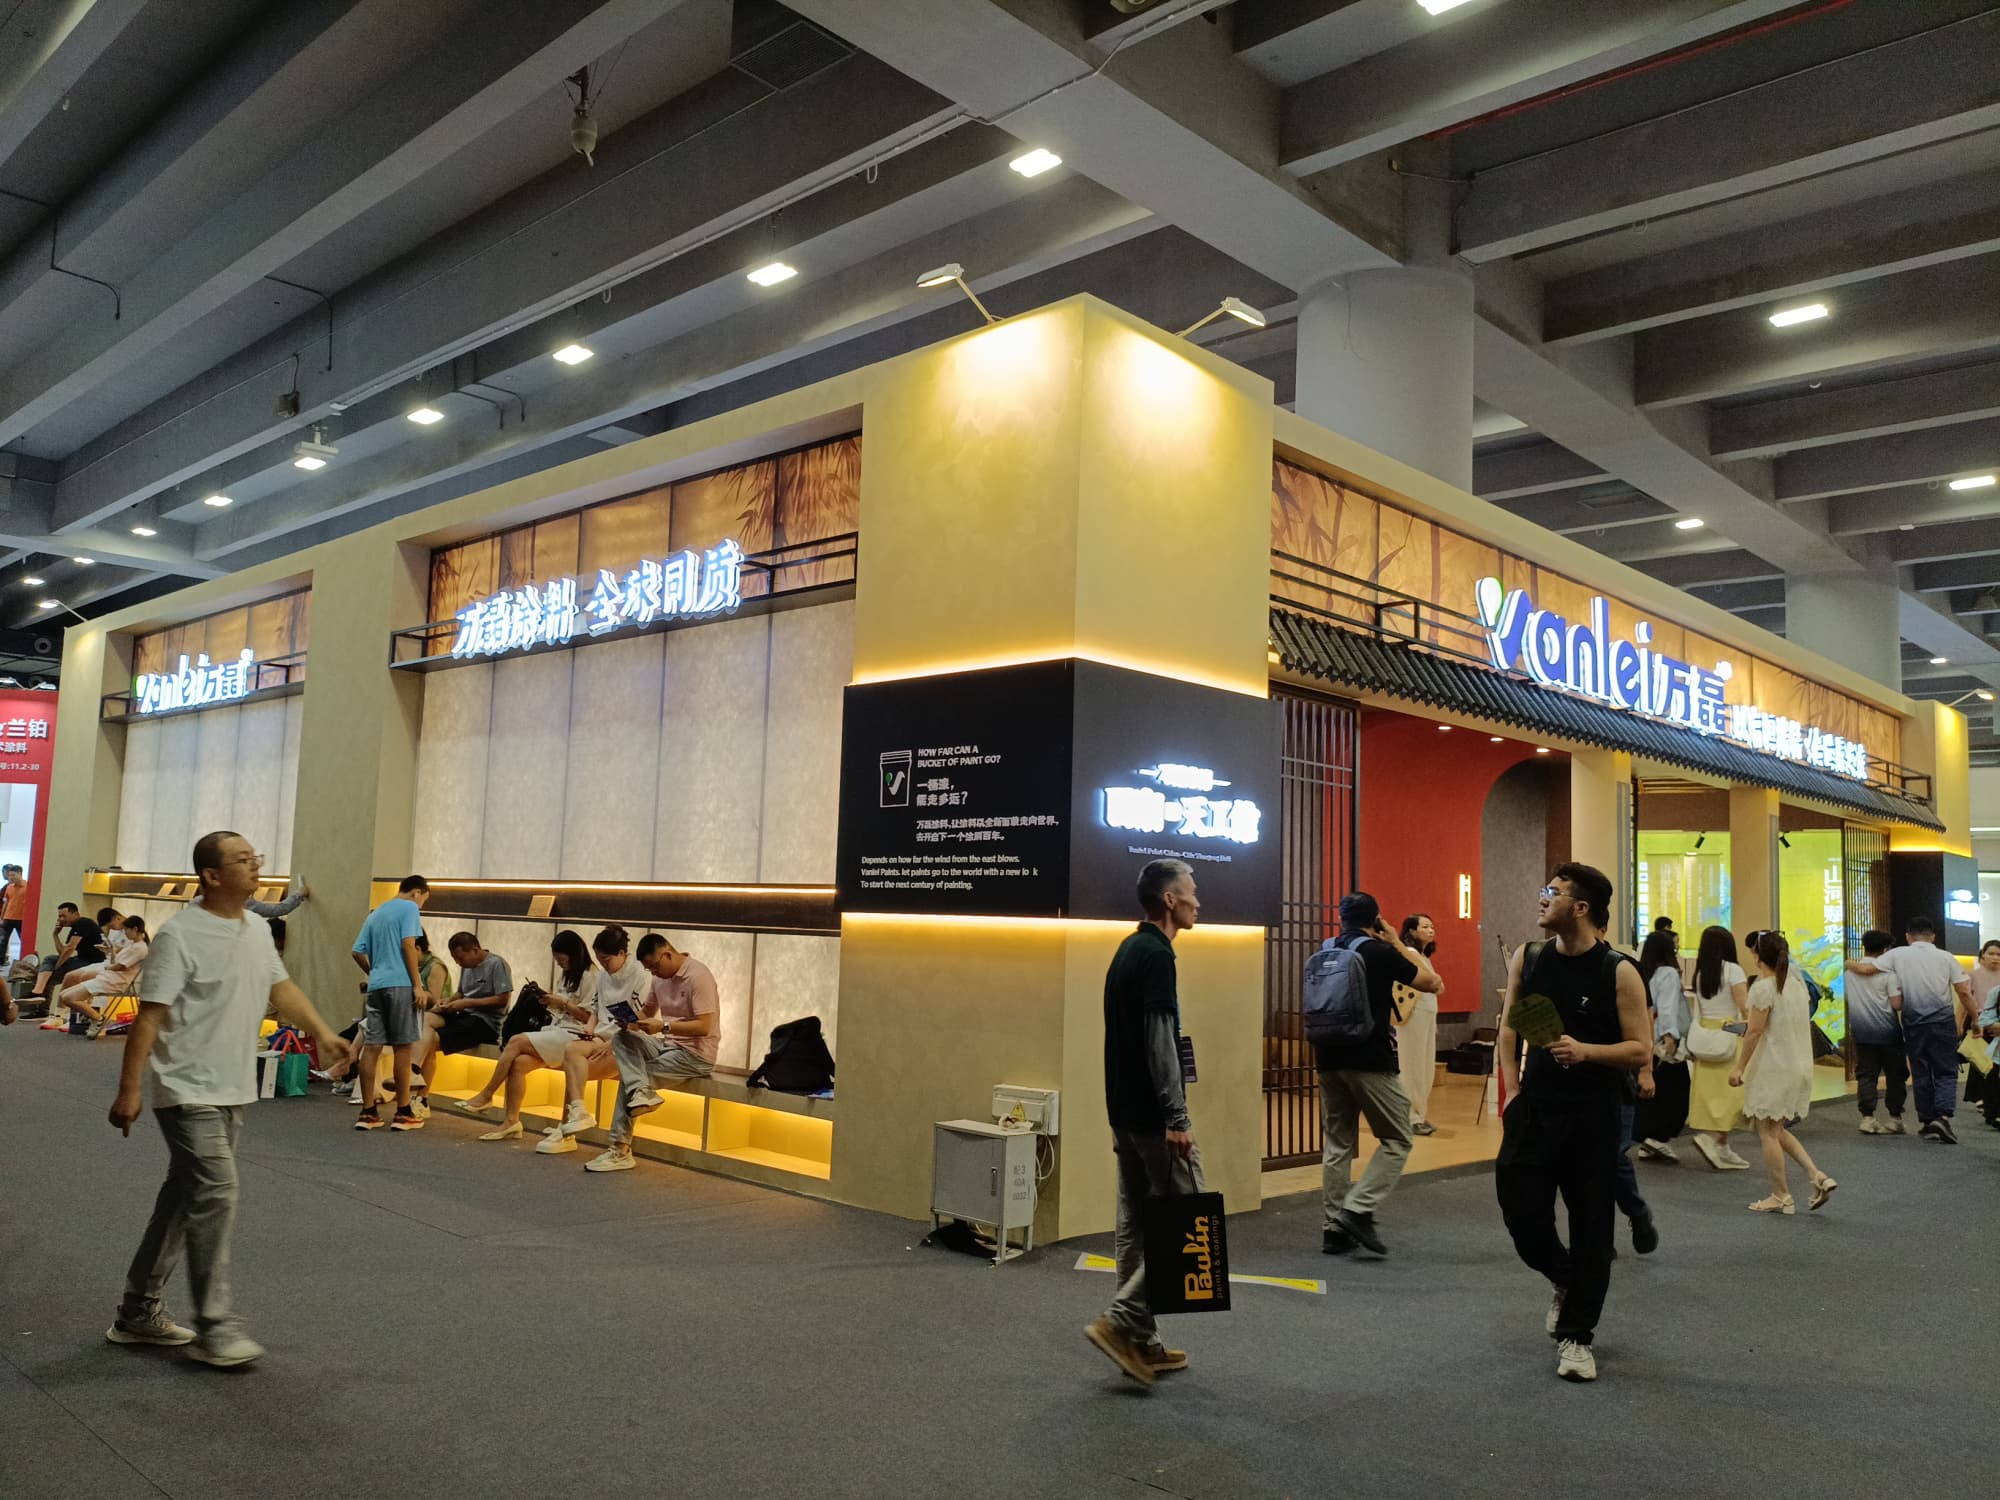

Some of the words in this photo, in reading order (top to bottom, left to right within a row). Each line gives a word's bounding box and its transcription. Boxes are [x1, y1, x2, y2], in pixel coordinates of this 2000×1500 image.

[918, 748, 937, 757] HOW
[938, 747, 954, 756] FAR
[954, 746, 971, 755] CAN
[972, 745, 980, 754] A
[917, 758, 947, 768] BUCKET
[947, 757, 959, 767] OF
[960, 756, 984, 766] PAINT
[984, 755, 1002, 764] GO?
[861, 856, 888, 865] Depends
[912, 855, 922, 863] far
[922, 855, 934, 863] the
[934, 855, 951, 863] wind
[951, 854, 968, 863] from
[969, 855, 981, 863] the
[981, 855, 996, 863] east
[901, 868, 910, 876] let
[910, 868, 931, 878] paints
[941, 868, 949, 876] to
[950, 867, 962, 876] the
[962, 867, 983, 876] world
[983, 867, 999, 876] with
[861, 880, 869, 888] To
[869, 880, 884, 888] start
[884, 880, 895, 888] the
[895, 880, 910, 888] next
[910, 880, 935, 890] century
[935, 880, 944, 888] of
